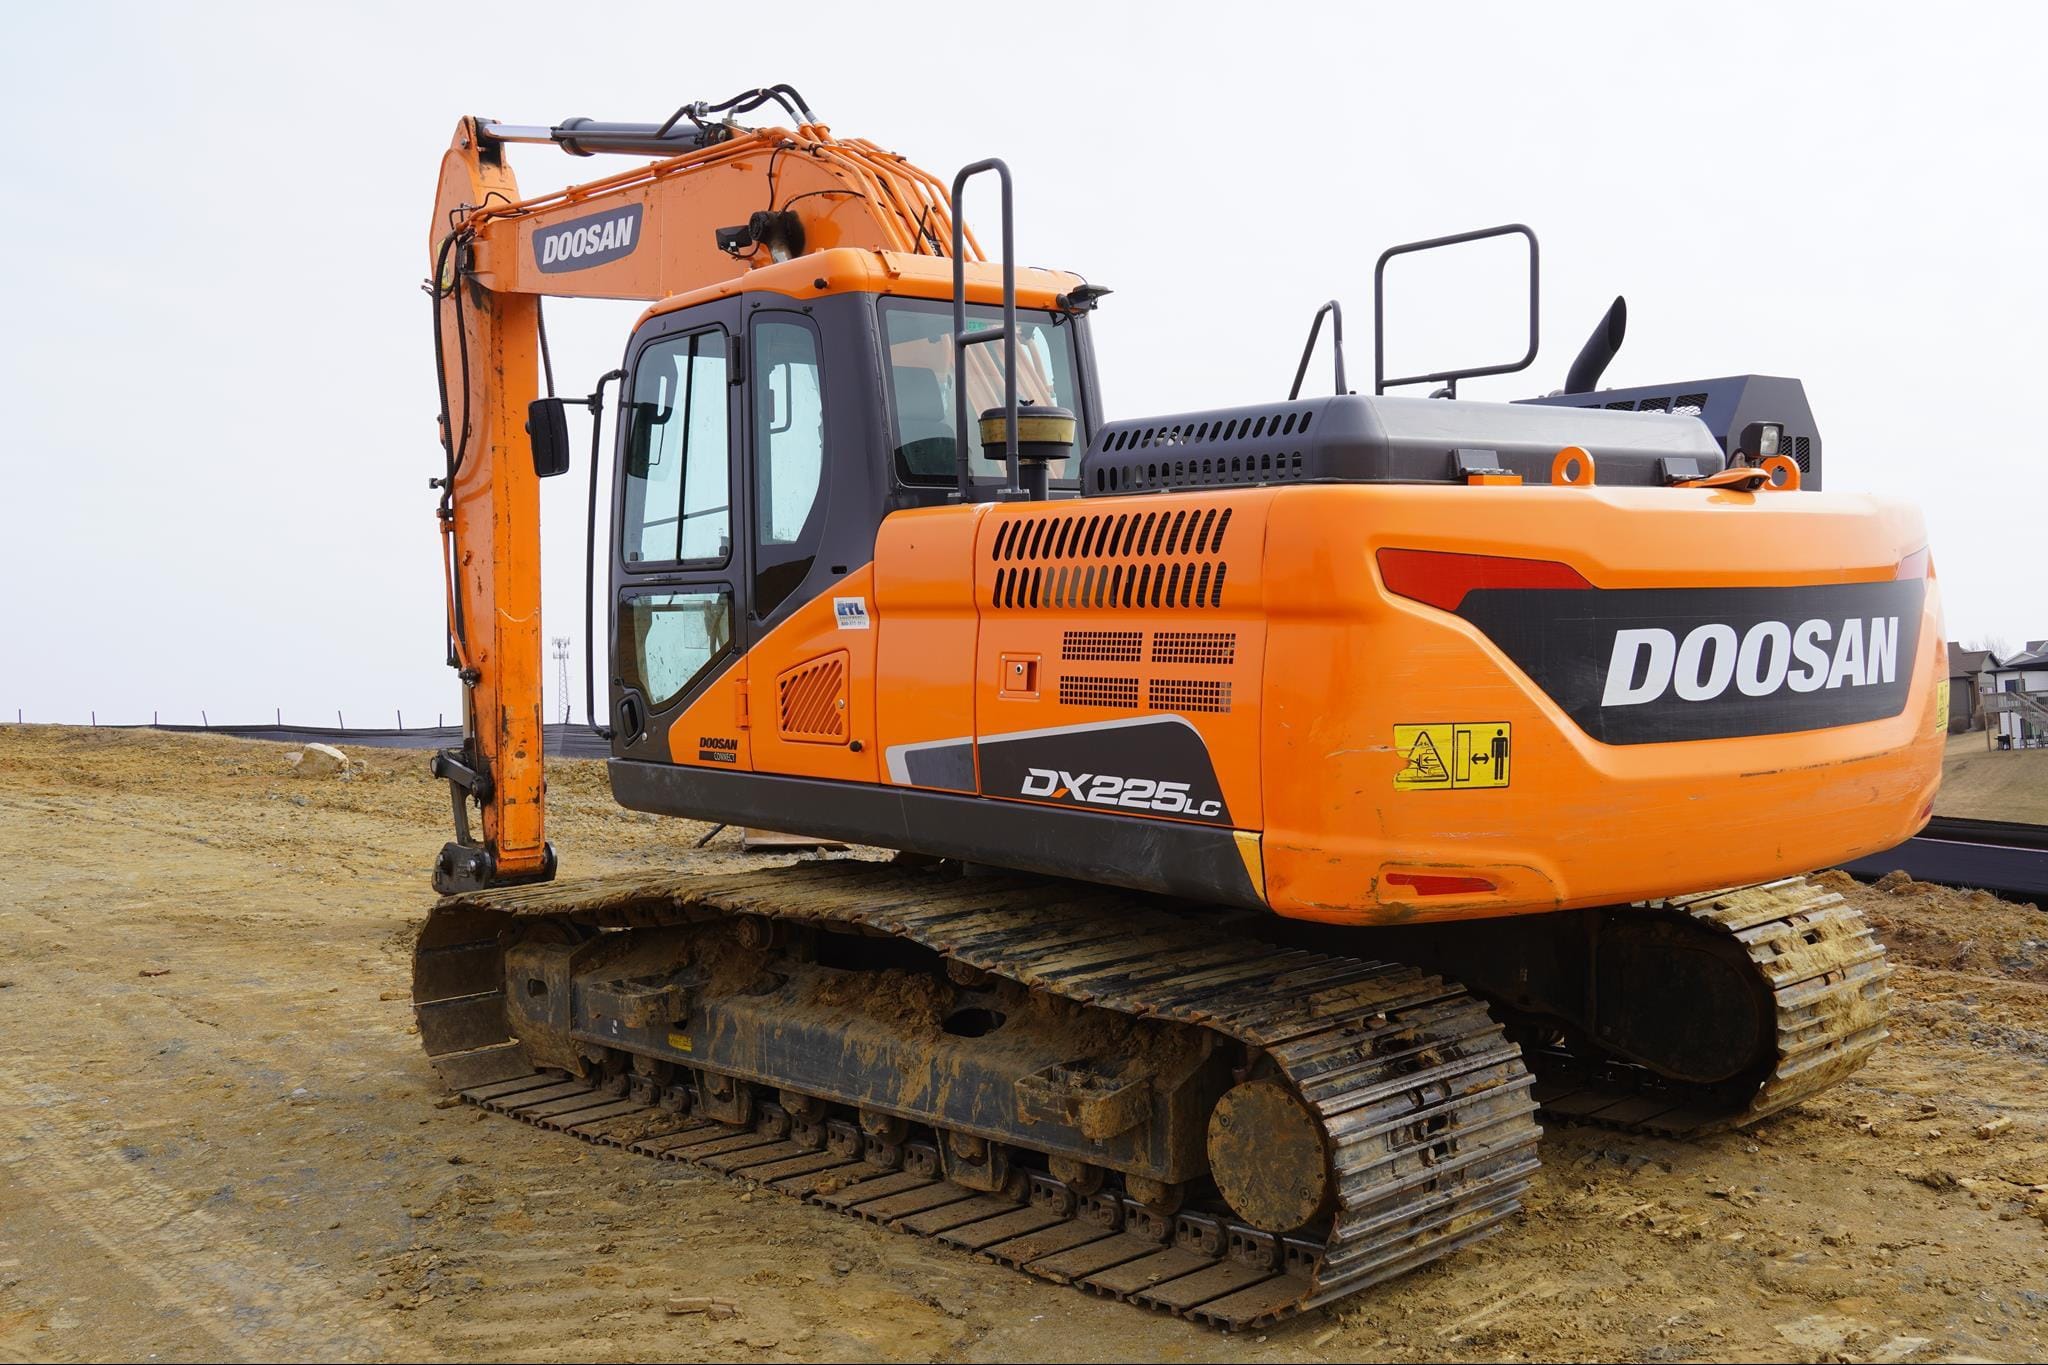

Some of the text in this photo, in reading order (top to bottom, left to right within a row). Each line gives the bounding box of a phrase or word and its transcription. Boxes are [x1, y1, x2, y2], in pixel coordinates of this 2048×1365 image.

[542, 215, 634, 265] DOOSAN
[1601, 616, 1899, 707] DOOSAN
[699, 736, 738, 750] DOOSAN
